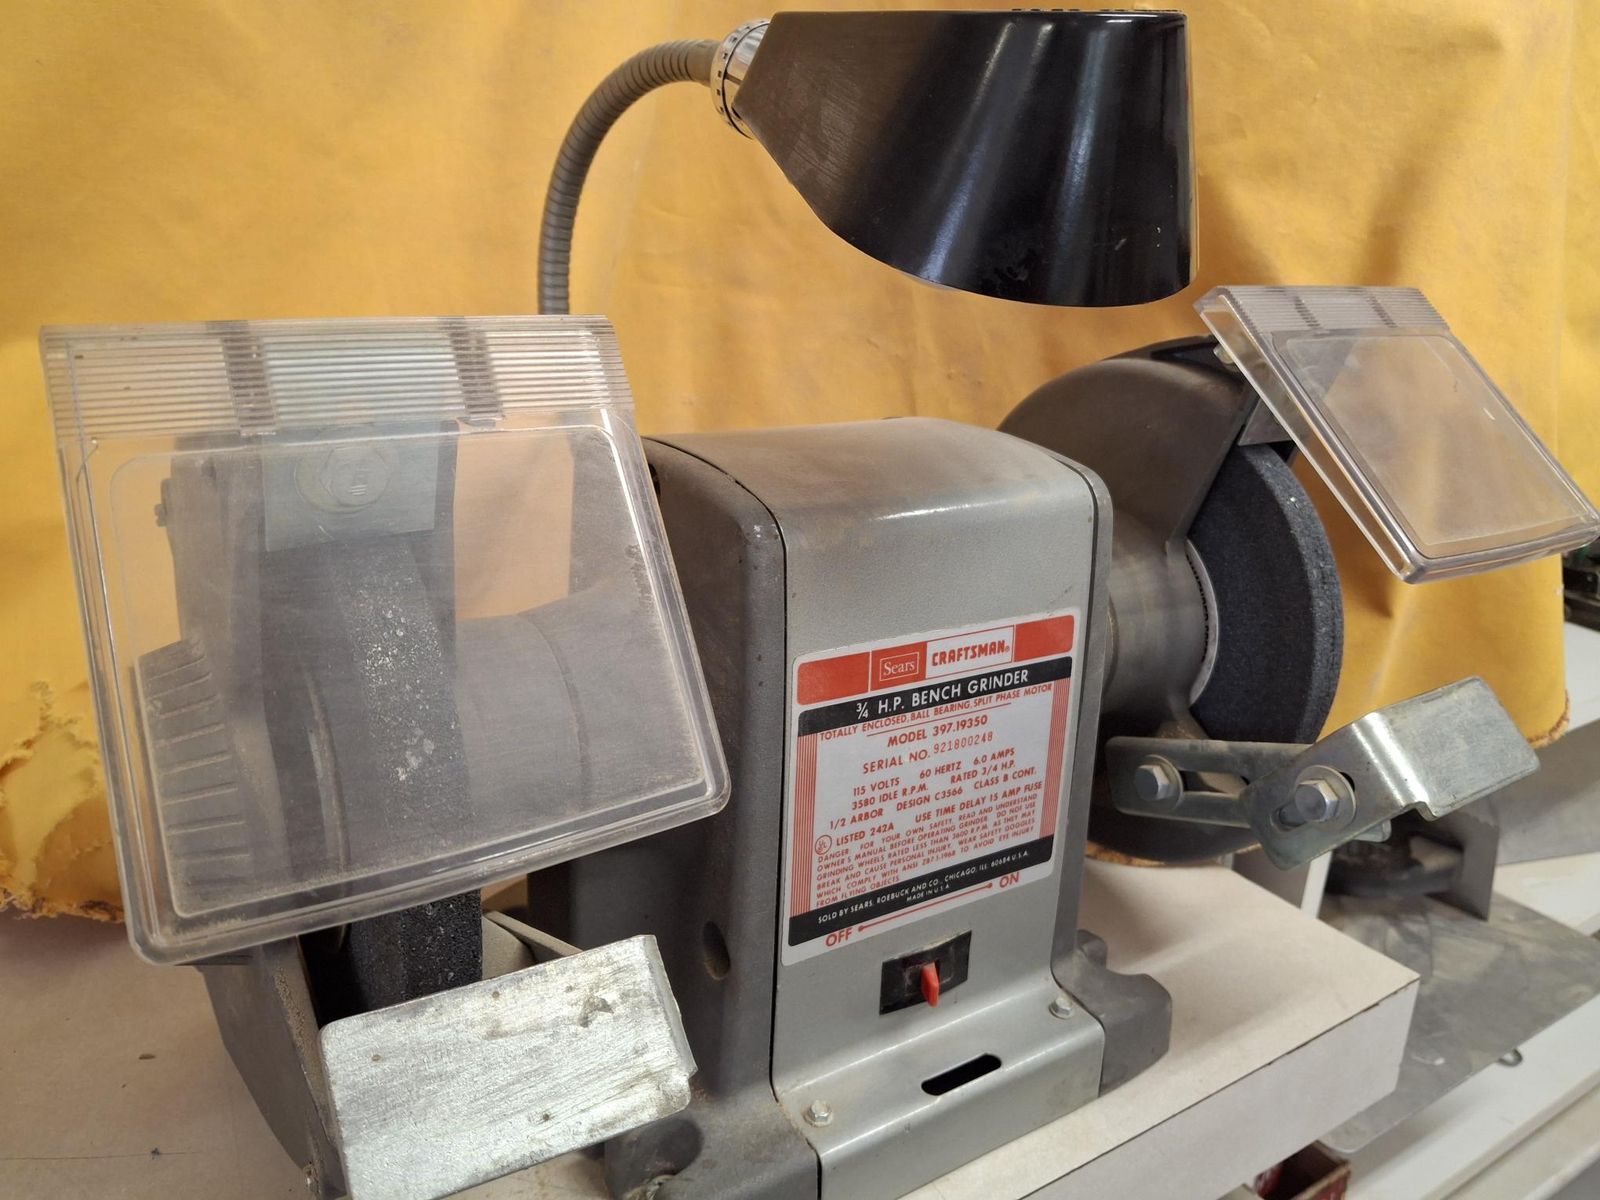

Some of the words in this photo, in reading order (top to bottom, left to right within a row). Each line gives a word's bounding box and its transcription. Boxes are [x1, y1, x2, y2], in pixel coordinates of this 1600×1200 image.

[883, 656, 915, 676] Sears
[820, 725, 857, 741] TOTALLY
[995, 689, 1020, 701] PHASE
[1023, 683, 1051, 695] MOTOR
[878, 695, 904, 714] H.P.
[911, 683, 960, 707] BENCH
[967, 668, 1028, 694] GRINDER
[862, 754, 903, 774] SERIAL
[908, 747, 930, 762] NO.
[933, 730, 993, 754] 921800248
[887, 728, 927, 747] MODEL
[933, 714, 987, 736] 397.19350
[852, 796, 875, 810] 3580
[879, 790, 897, 802] IDLE
[902, 782, 928, 797] R.P.M.
[950, 769, 977, 784] RATED
[981, 764, 997, 776] 3/4
[1001, 759, 1015, 770] H.P.
[853, 785, 865, 796] 115
[870, 776, 899, 792] VOLTS
[919, 768, 931, 779] 60
[934, 761, 961, 775] HERTZ
[973, 754, 987, 765] 6.0
[990, 747, 1014, 760] AMPS
[830, 817, 846, 831] 1/2
[850, 807, 883, 824] ARBOR
[896, 794, 930, 811] DESIGN
[934, 786, 962, 800] C3566
[973, 775, 999, 790] CLASS
[1003, 773, 1008, 782] B
[1012, 765, 1036, 780] CONT.
[836, 830, 865, 846] LISTED
[870, 821, 893, 836] 242A
[915, 811, 931, 823] USE
[936, 804, 955, 817] TIME
[959, 795, 985, 810] DELAY
[990, 792, 998, 801] 15
[1001, 786, 1020, 798] AMP
[1023, 780, 1041, 793] FUSE
[817, 856, 851, 871] OWNERS
[855, 845, 886, 860] MANUAL
[890, 837, 914, 850] BEFORE
[917, 824, 955, 841] OPERATING
[996, 809, 1006, 817] DO
[1009, 805, 1022, 814] NOT
[860, 840, 873, 850] FOR
[882, 833, 900, 843] YOUR
[905, 826, 923, 837] OWN
[959, 811, 975, 821] READ
[978, 806, 992, 815] AND
[995, 793, 1037, 810] UNDERSTAND
[816, 864, 853, 881] GRINDING
[858, 854, 884, 868] WHEELS
[887, 847, 909, 859] RATED
[913, 841, 927, 851] LESS
[930, 835, 948, 846] THAN
[816, 877, 840, 890] BREAK
[845, 871, 860, 881] AND
[864, 862, 886, 875] CAUSE
[890, 851, 924, 866] PERSONAL
[958, 835, 976, 845] WEAR
[979, 827, 1001, 839] SAFETY
[816, 886, 840, 899] WHICH
[847, 874, 875, 889] COMPLY
[881, 867, 898, 878] WITH
[960, 845, 968, 853] TO
[973, 838, 994, 849] AVOID
[999, 871, 1018, 888] ON
[816, 895, 837, 907] FROM
[841, 885, 866, 899] FLYING
[818, 911, 836, 923] SOLD
[839, 907, 848, 916] BY
[876, 888, 909, 904] ROEBUCK
[911, 882, 926, 893] AND
[906, 891, 923, 901] MADE
[825, 926, 852, 947] OFF
